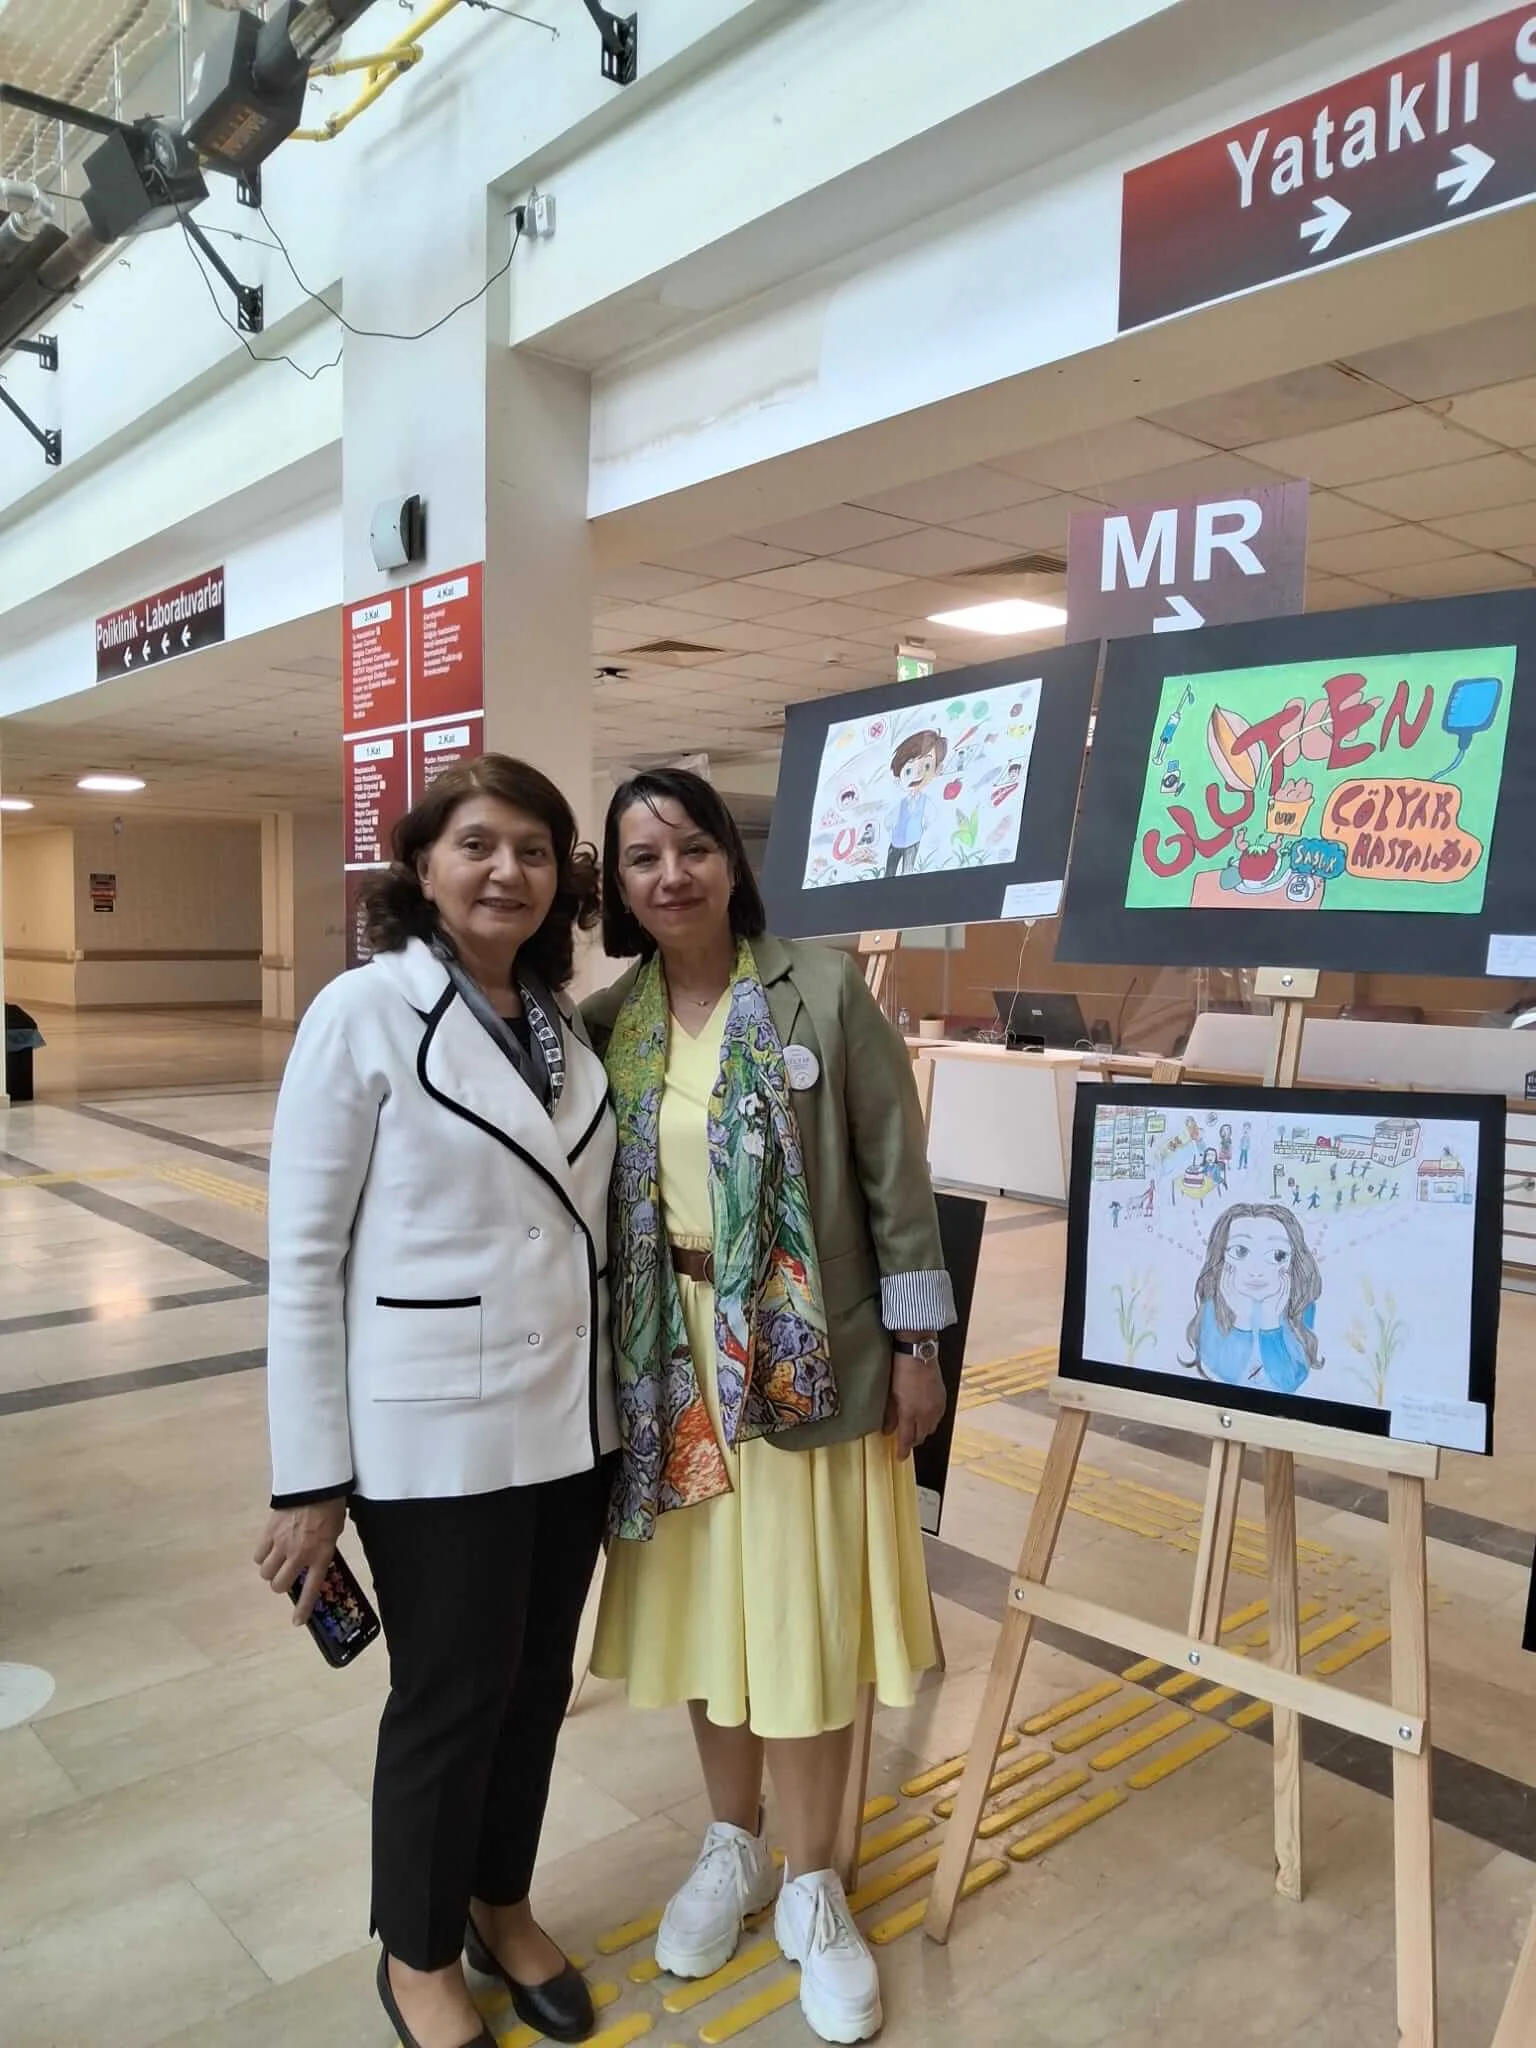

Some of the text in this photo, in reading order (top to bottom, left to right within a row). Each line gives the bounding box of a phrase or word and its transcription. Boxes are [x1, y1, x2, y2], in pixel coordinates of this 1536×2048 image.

[1227, 52, 1480, 209] Yataklı
[1101, 499, 1266, 593] MR
[96, 608, 139, 652] Poliklinik
[145, 576, 223, 633] Laboratuvarlar
